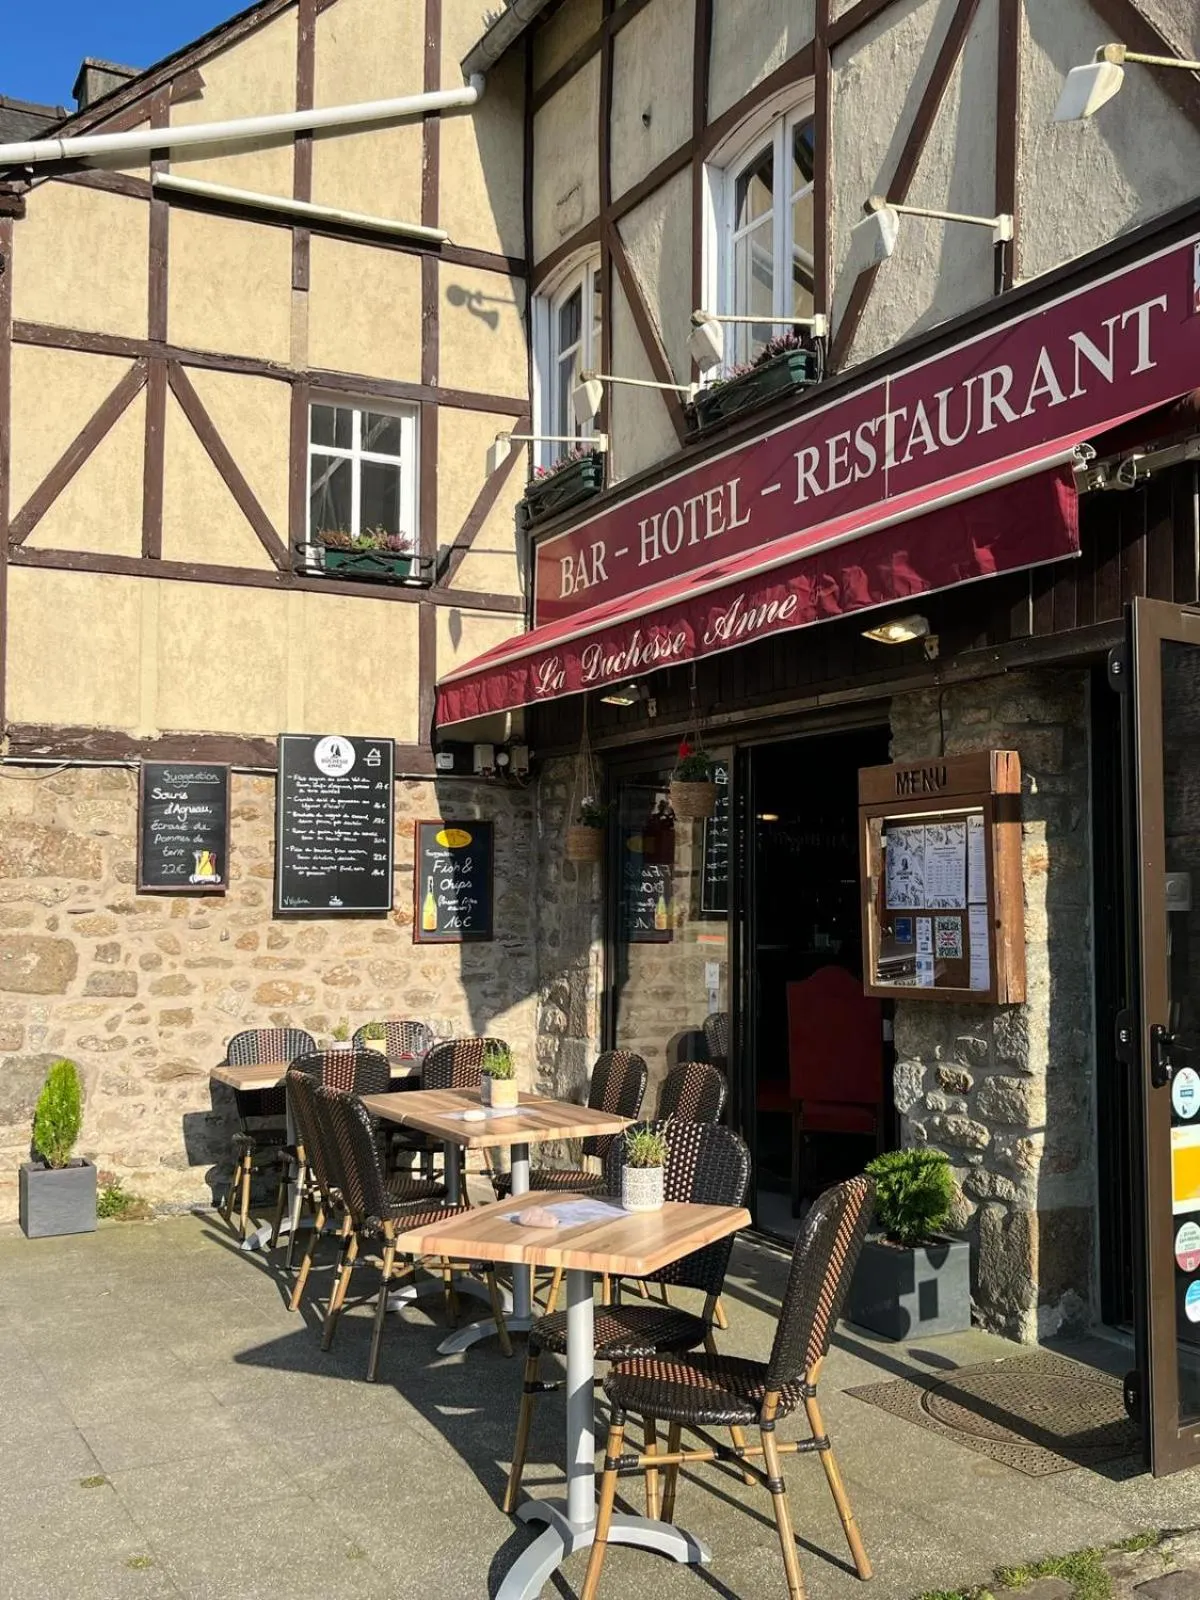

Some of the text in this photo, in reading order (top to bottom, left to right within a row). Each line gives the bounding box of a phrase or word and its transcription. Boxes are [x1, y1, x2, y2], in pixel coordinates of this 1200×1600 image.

[559, 540, 608, 599] BAR
[638, 477, 751, 567] HOTEL
[793, 294, 1168, 505] RESTAURANT
[535, 593, 798, 694] La Duchesse Anne
[895, 766, 948, 795] MENU
[150, 787, 188, 800] Souris
[461, 857, 473, 874] &
[439, 878, 473, 895] Chips
